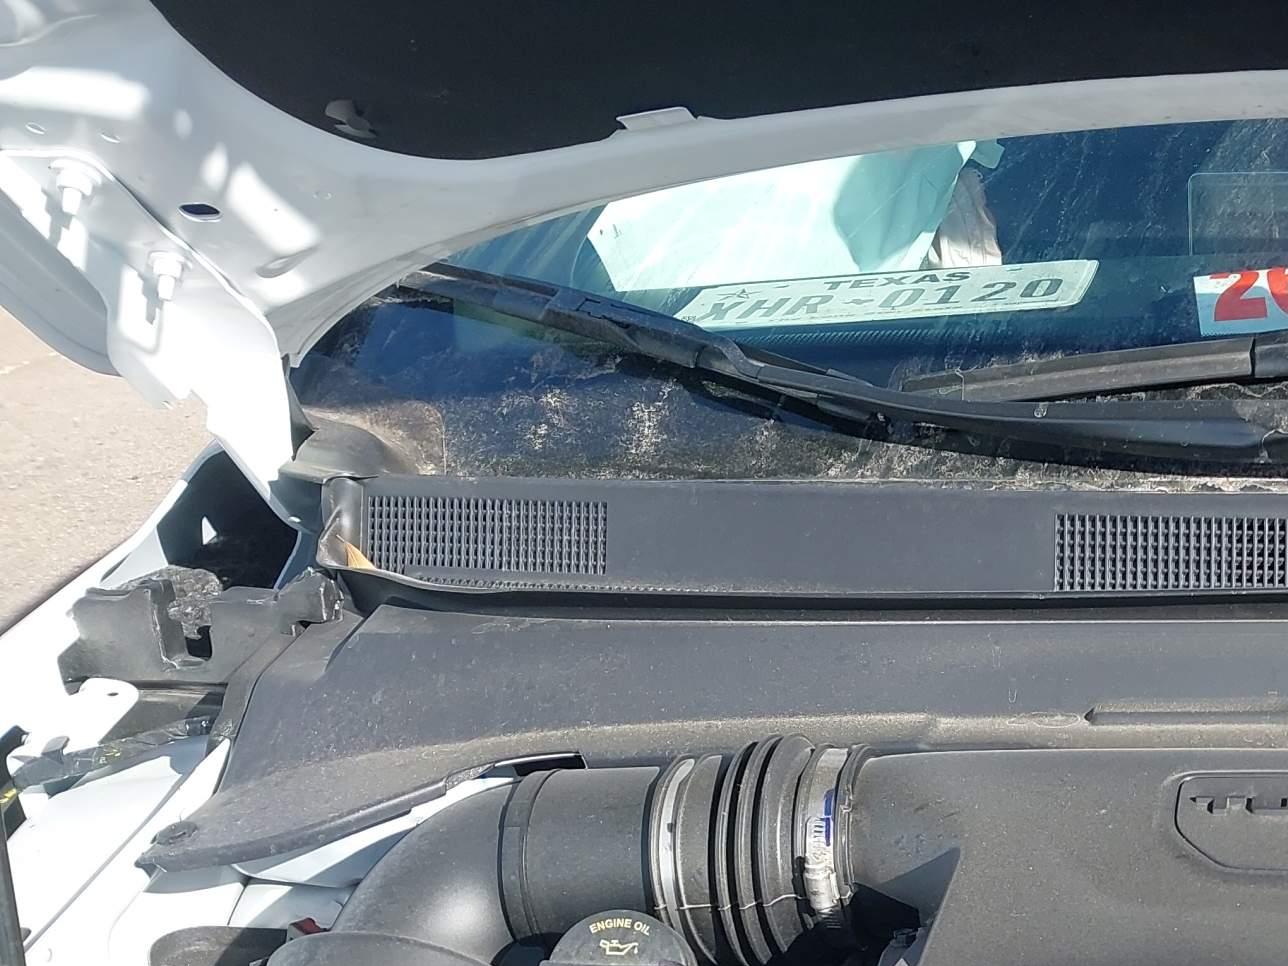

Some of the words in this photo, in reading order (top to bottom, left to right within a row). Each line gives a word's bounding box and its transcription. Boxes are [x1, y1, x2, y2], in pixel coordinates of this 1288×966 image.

[823, 271, 973, 290] TEXAS
[697, 294, 836, 321] XHR
[877, 277, 1065, 310] 0120
[588, 917, 633, 935] ENGINE
[633, 920, 653, 936] OIL
